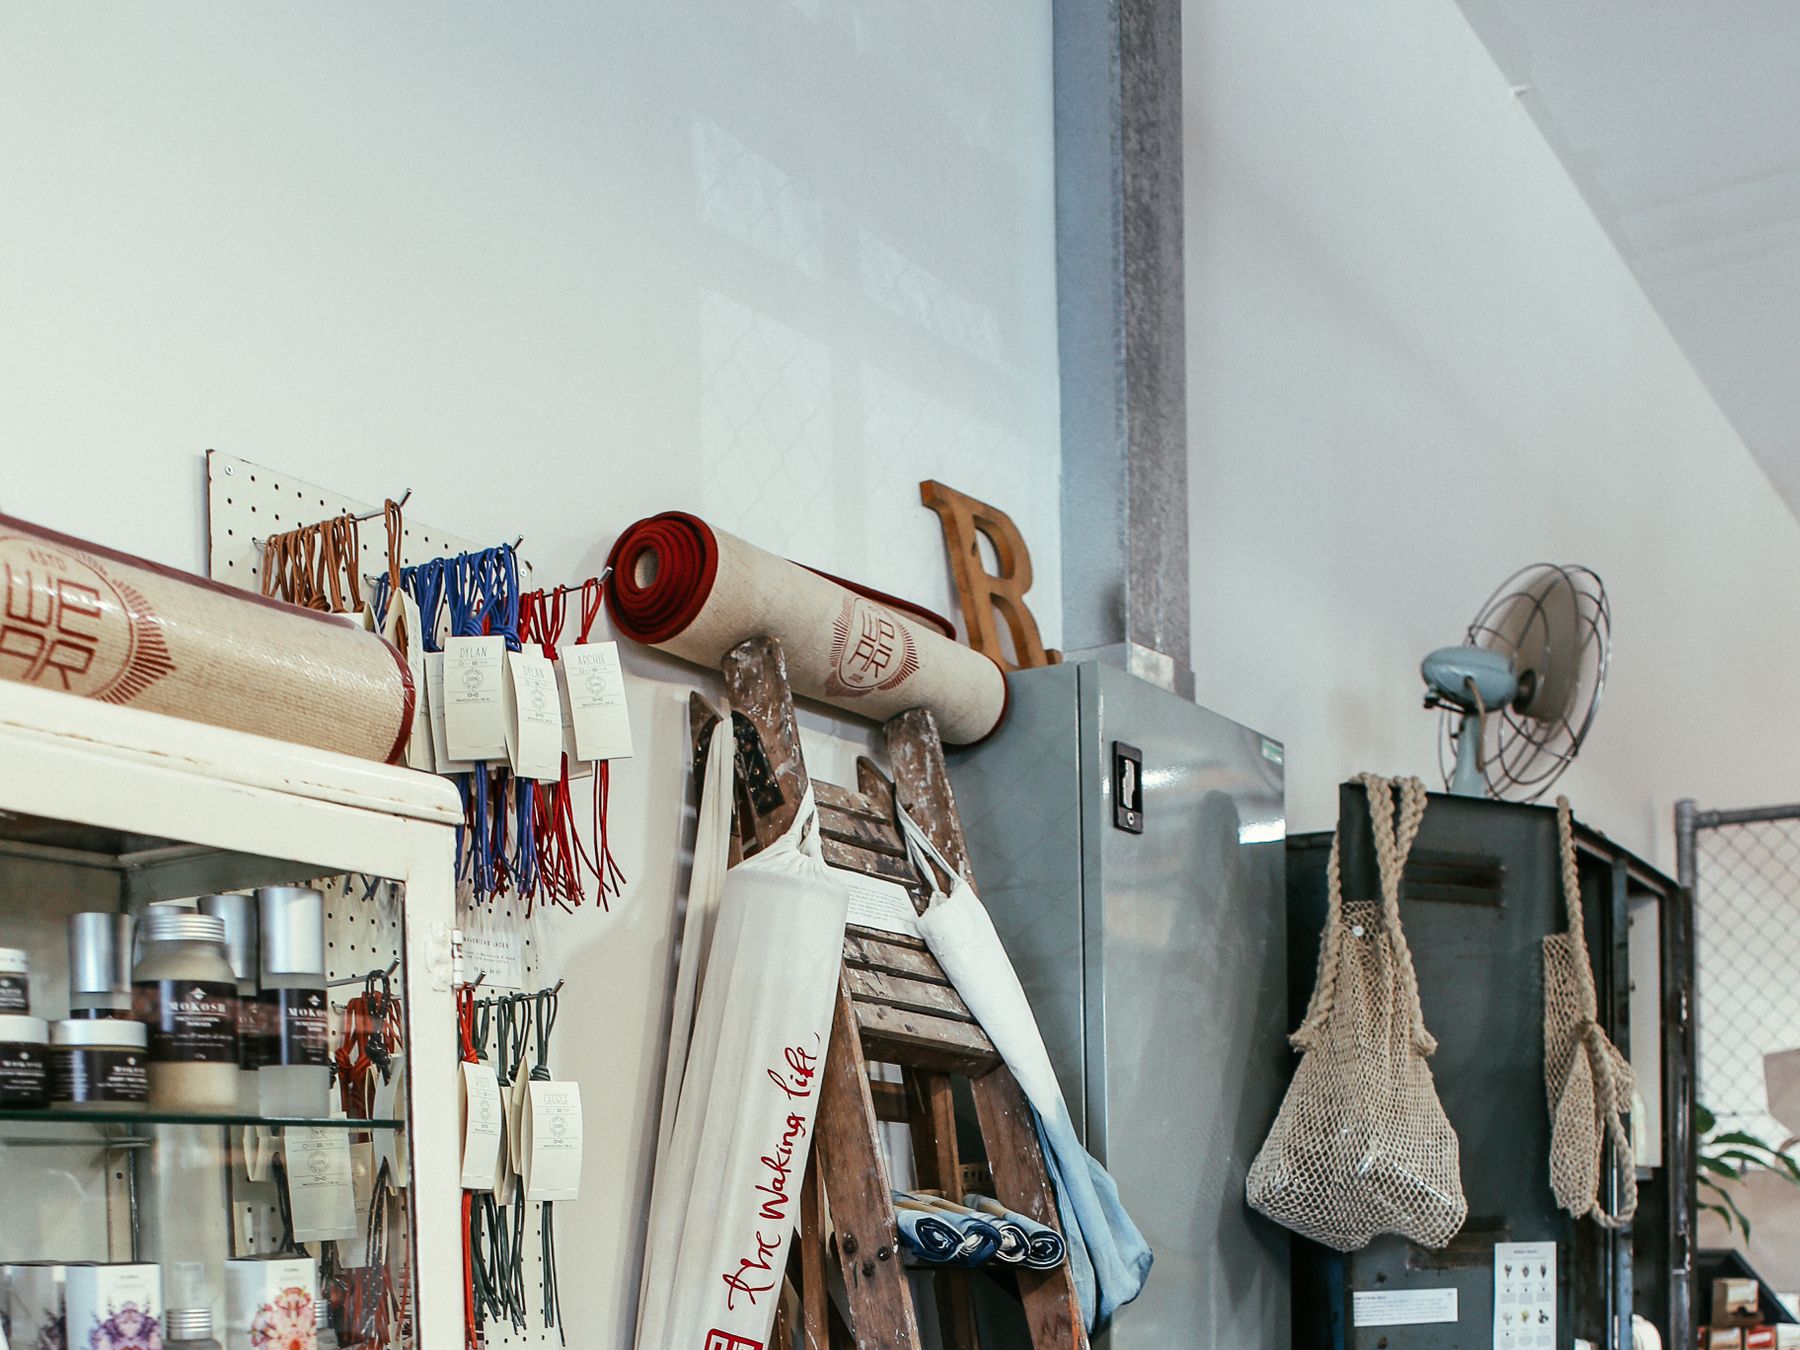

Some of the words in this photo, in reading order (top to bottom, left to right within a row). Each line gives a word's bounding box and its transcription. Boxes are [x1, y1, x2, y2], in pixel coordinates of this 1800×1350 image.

[919, 479, 1063, 672] R
[459, 647, 488, 659] DYLAN
[755, 1112, 807, 1220] Waking
